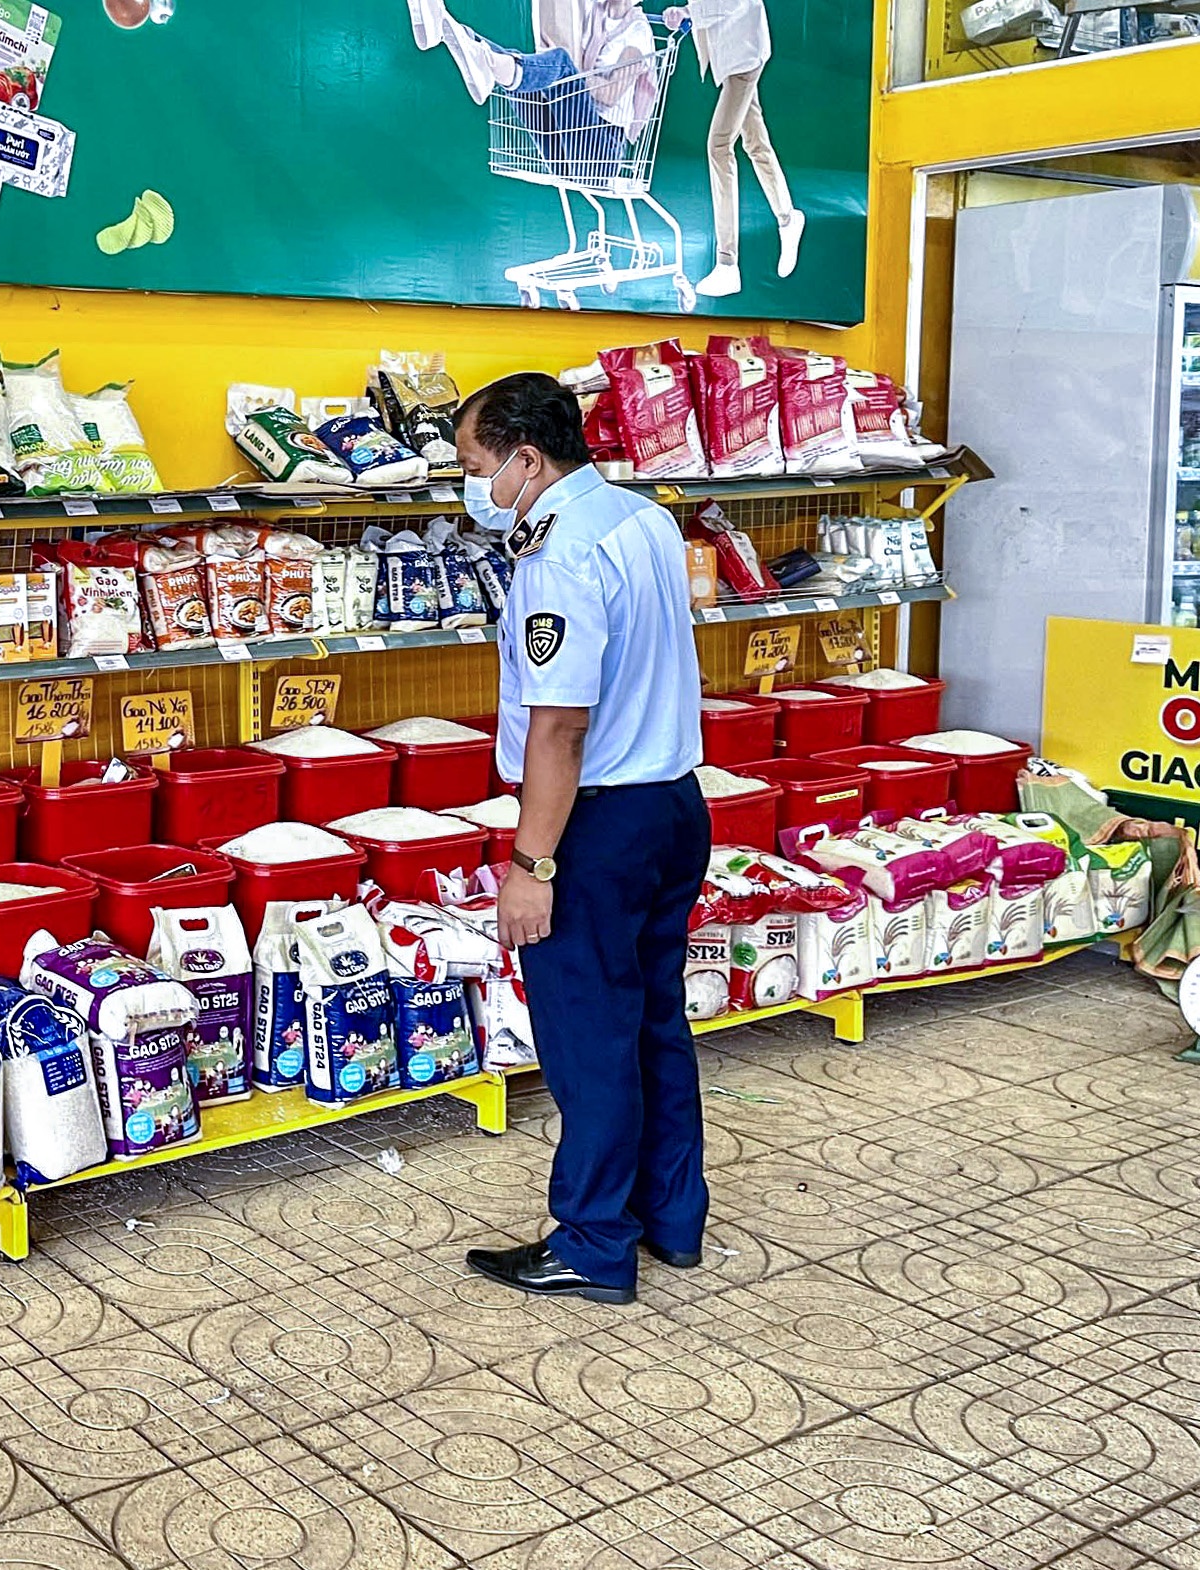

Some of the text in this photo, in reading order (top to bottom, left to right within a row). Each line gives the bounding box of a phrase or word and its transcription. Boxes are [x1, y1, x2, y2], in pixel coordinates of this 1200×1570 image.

[6, 134, 25, 149] Puri
[532, 617, 554, 628] DMS
[212, 992, 239, 1008] ST25
